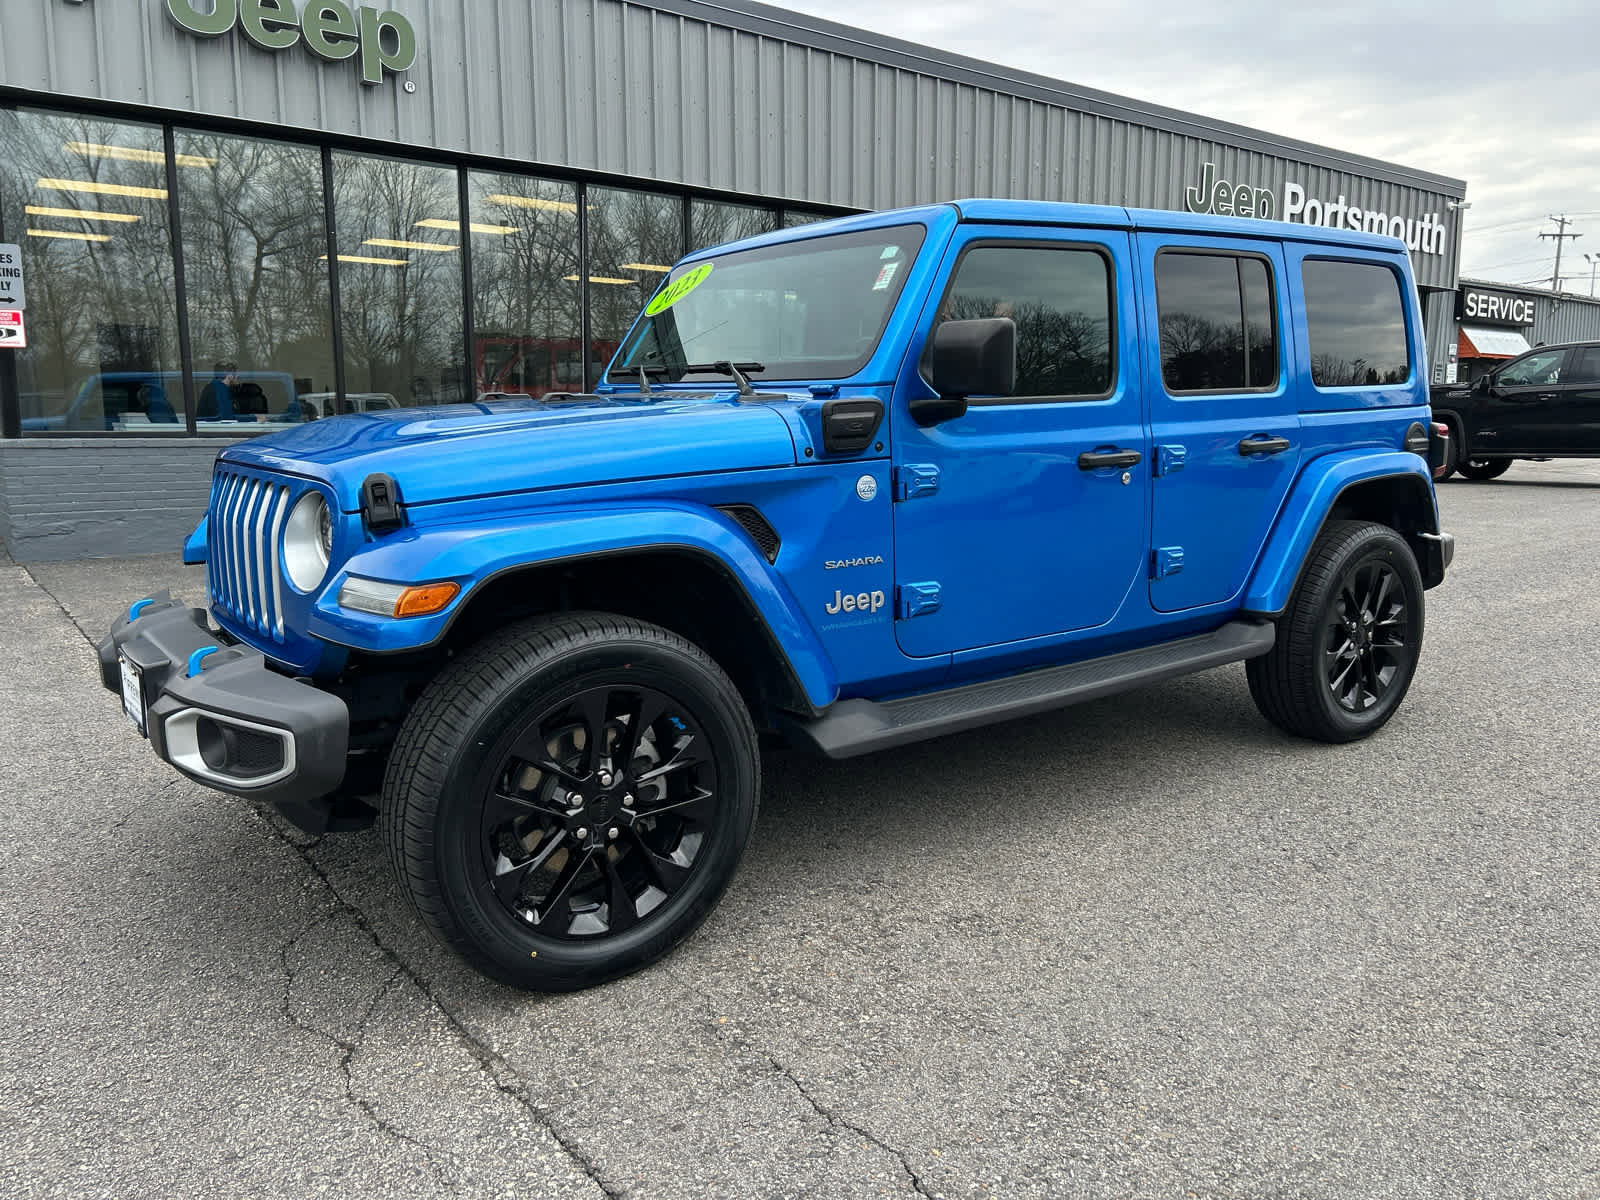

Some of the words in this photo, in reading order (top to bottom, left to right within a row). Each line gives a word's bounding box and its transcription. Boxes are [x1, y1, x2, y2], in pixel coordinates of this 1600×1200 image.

[1186, 162, 1276, 220] Jeep
[1283, 181, 1447, 256] Portsmouth
[1465, 292, 1535, 323] SERVICE
[824, 555, 884, 570] SAHARA
[825, 590, 885, 615] Jeep
